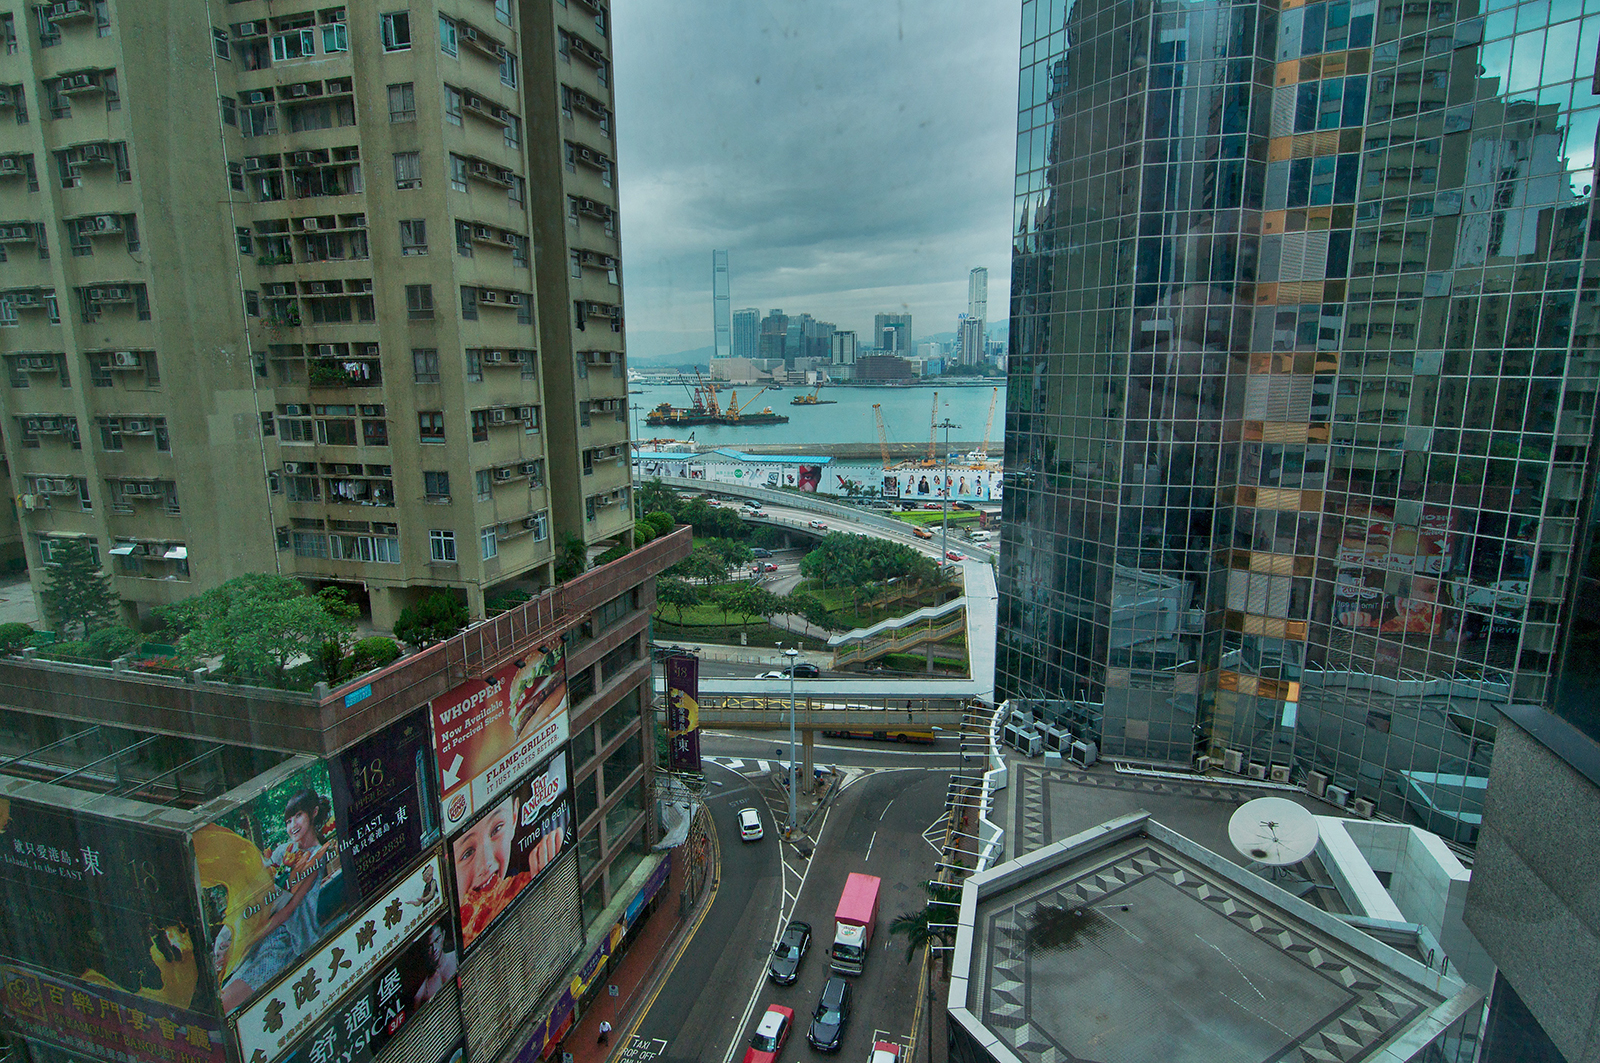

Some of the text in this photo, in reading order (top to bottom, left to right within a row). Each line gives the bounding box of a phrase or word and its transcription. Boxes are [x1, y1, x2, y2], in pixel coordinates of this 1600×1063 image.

[441, 724, 462, 744] Now
[464, 699, 504, 729] Available
[442, 708, 505, 754] at Percival Street
[359, 758, 384, 794] 18
[486, 734, 560, 795] IT JUST TASTES BETTER.
[533, 775, 548, 795] FAT
[449, 800, 466, 820] KING
[518, 827, 541, 852] Time
[541, 818, 550, 831] to
[551, 799, 567, 821] eat!
[33, 860, 42, 870] In
[43, 863, 57, 875] the
[59, 866, 83, 881] EAST
[128, 859, 160, 894] 18
[243, 903, 261, 920] On
[264, 889, 282, 906] the
[285, 858, 323, 890] Island.
[325, 849, 337, 863] In
[339, 837, 355, 853] the
[357, 813, 382, 840] EAST
[43, 982, 213, 1051] 百樂門宴會廳
[53, 1012, 119, 1044] PARAMOUNT
[123, 1034, 176, 1061] BANQUET
[308, 967, 402, 1063] 舒適堡
[633, 1039, 651, 1050] TAXI
[639, 1051, 657, 1061] OFF
